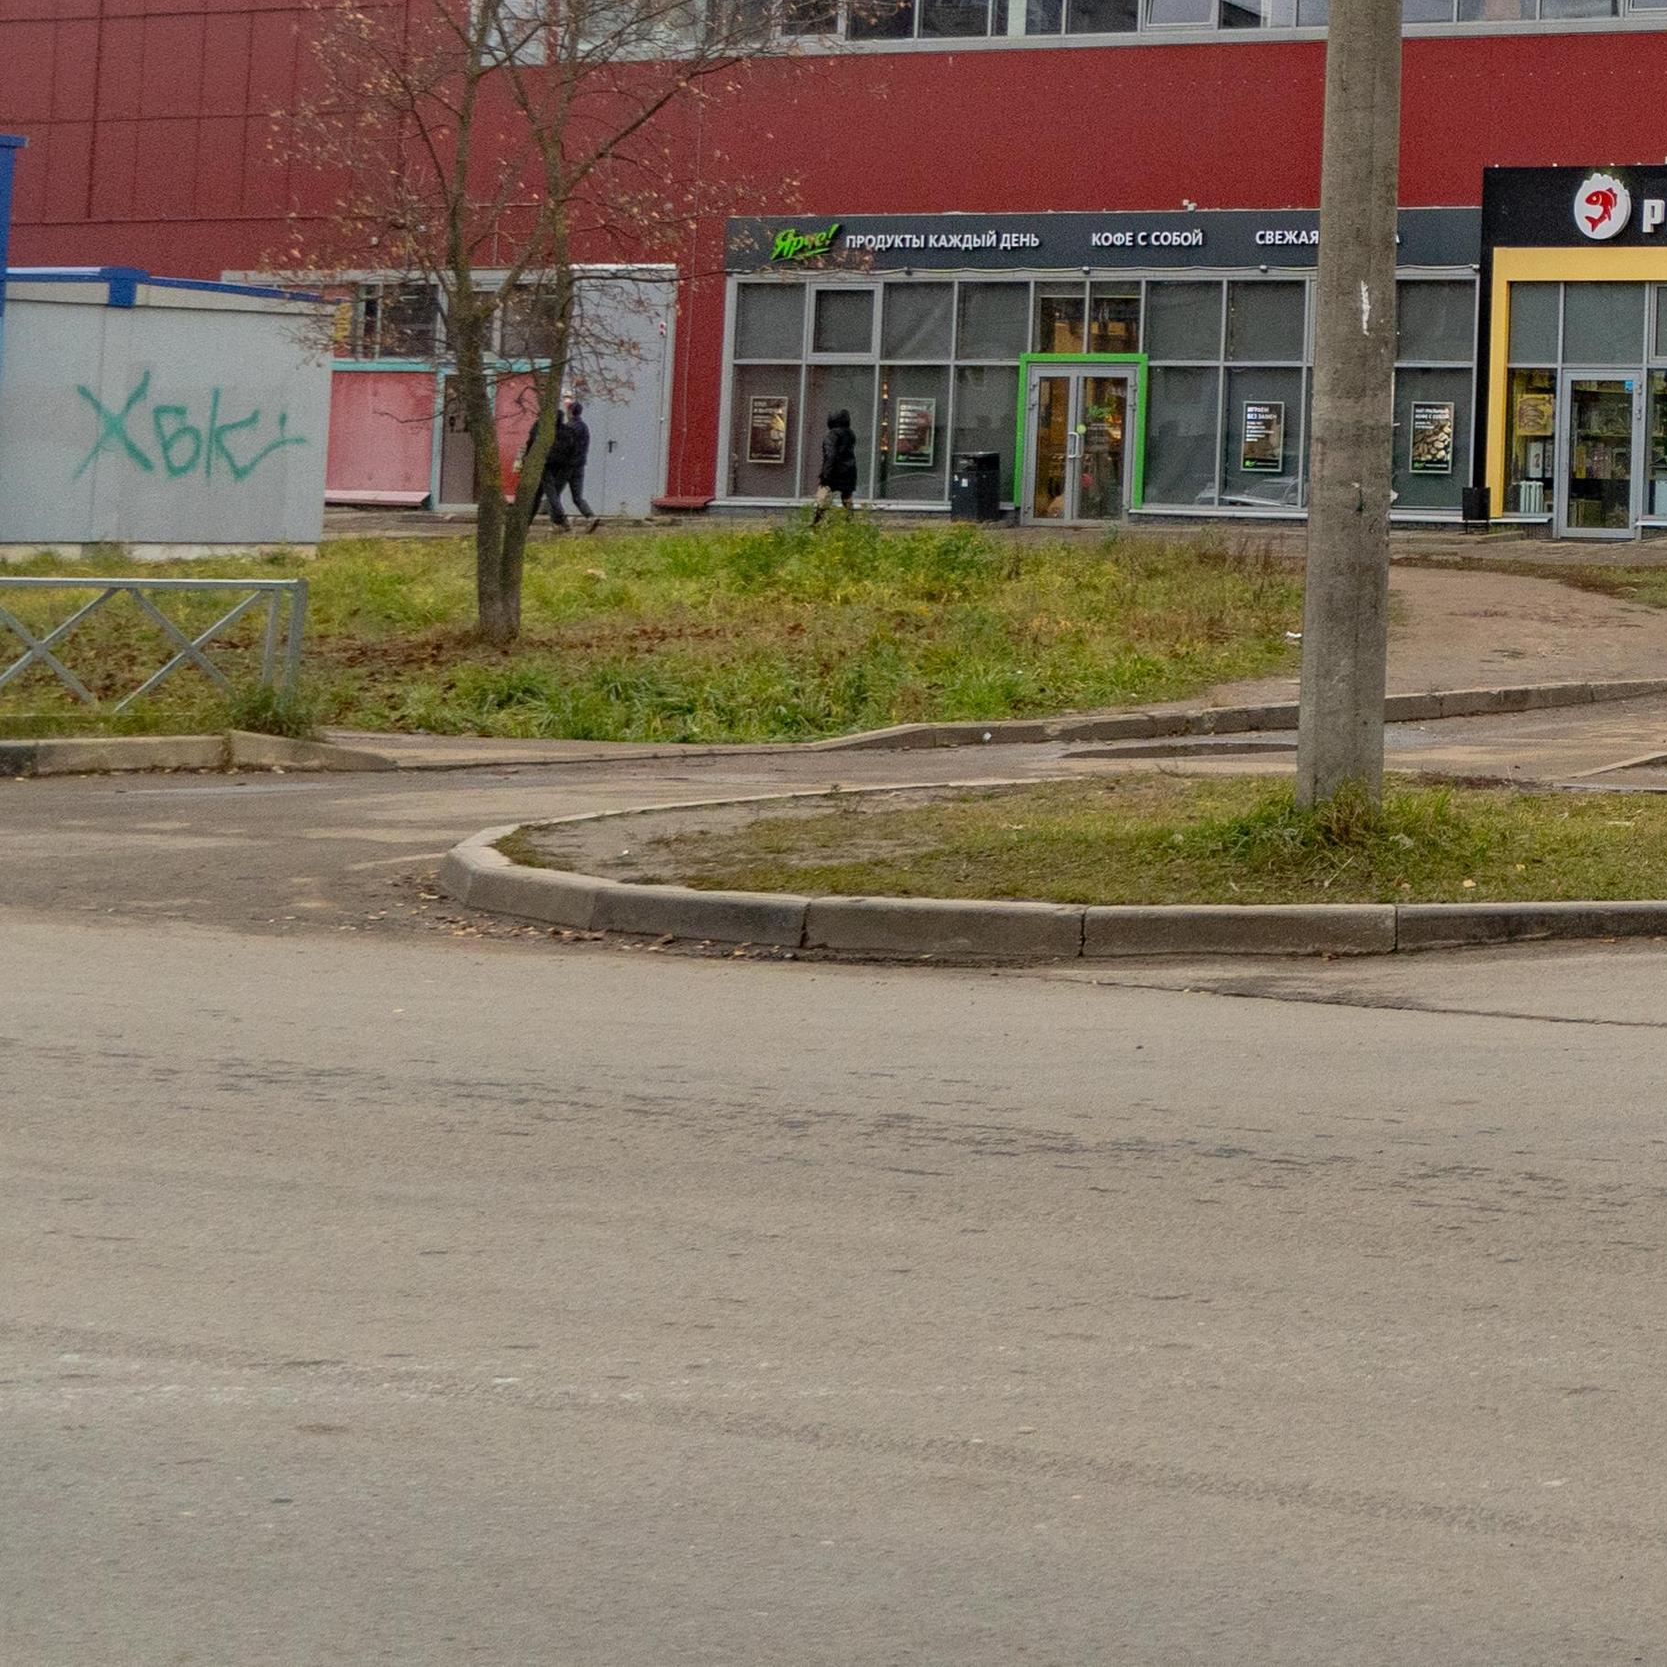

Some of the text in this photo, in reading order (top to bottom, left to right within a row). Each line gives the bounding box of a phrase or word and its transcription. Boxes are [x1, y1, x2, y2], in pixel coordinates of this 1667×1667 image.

[846, 230, 1040, 251] ПРОДУКТЫ КАЖДЫЙ ДЕНЬ
[1091, 229, 1203, 247] КОФЕ С СОБОЙ
[1255, 230, 1319, 245] СВЕЖАЯ
